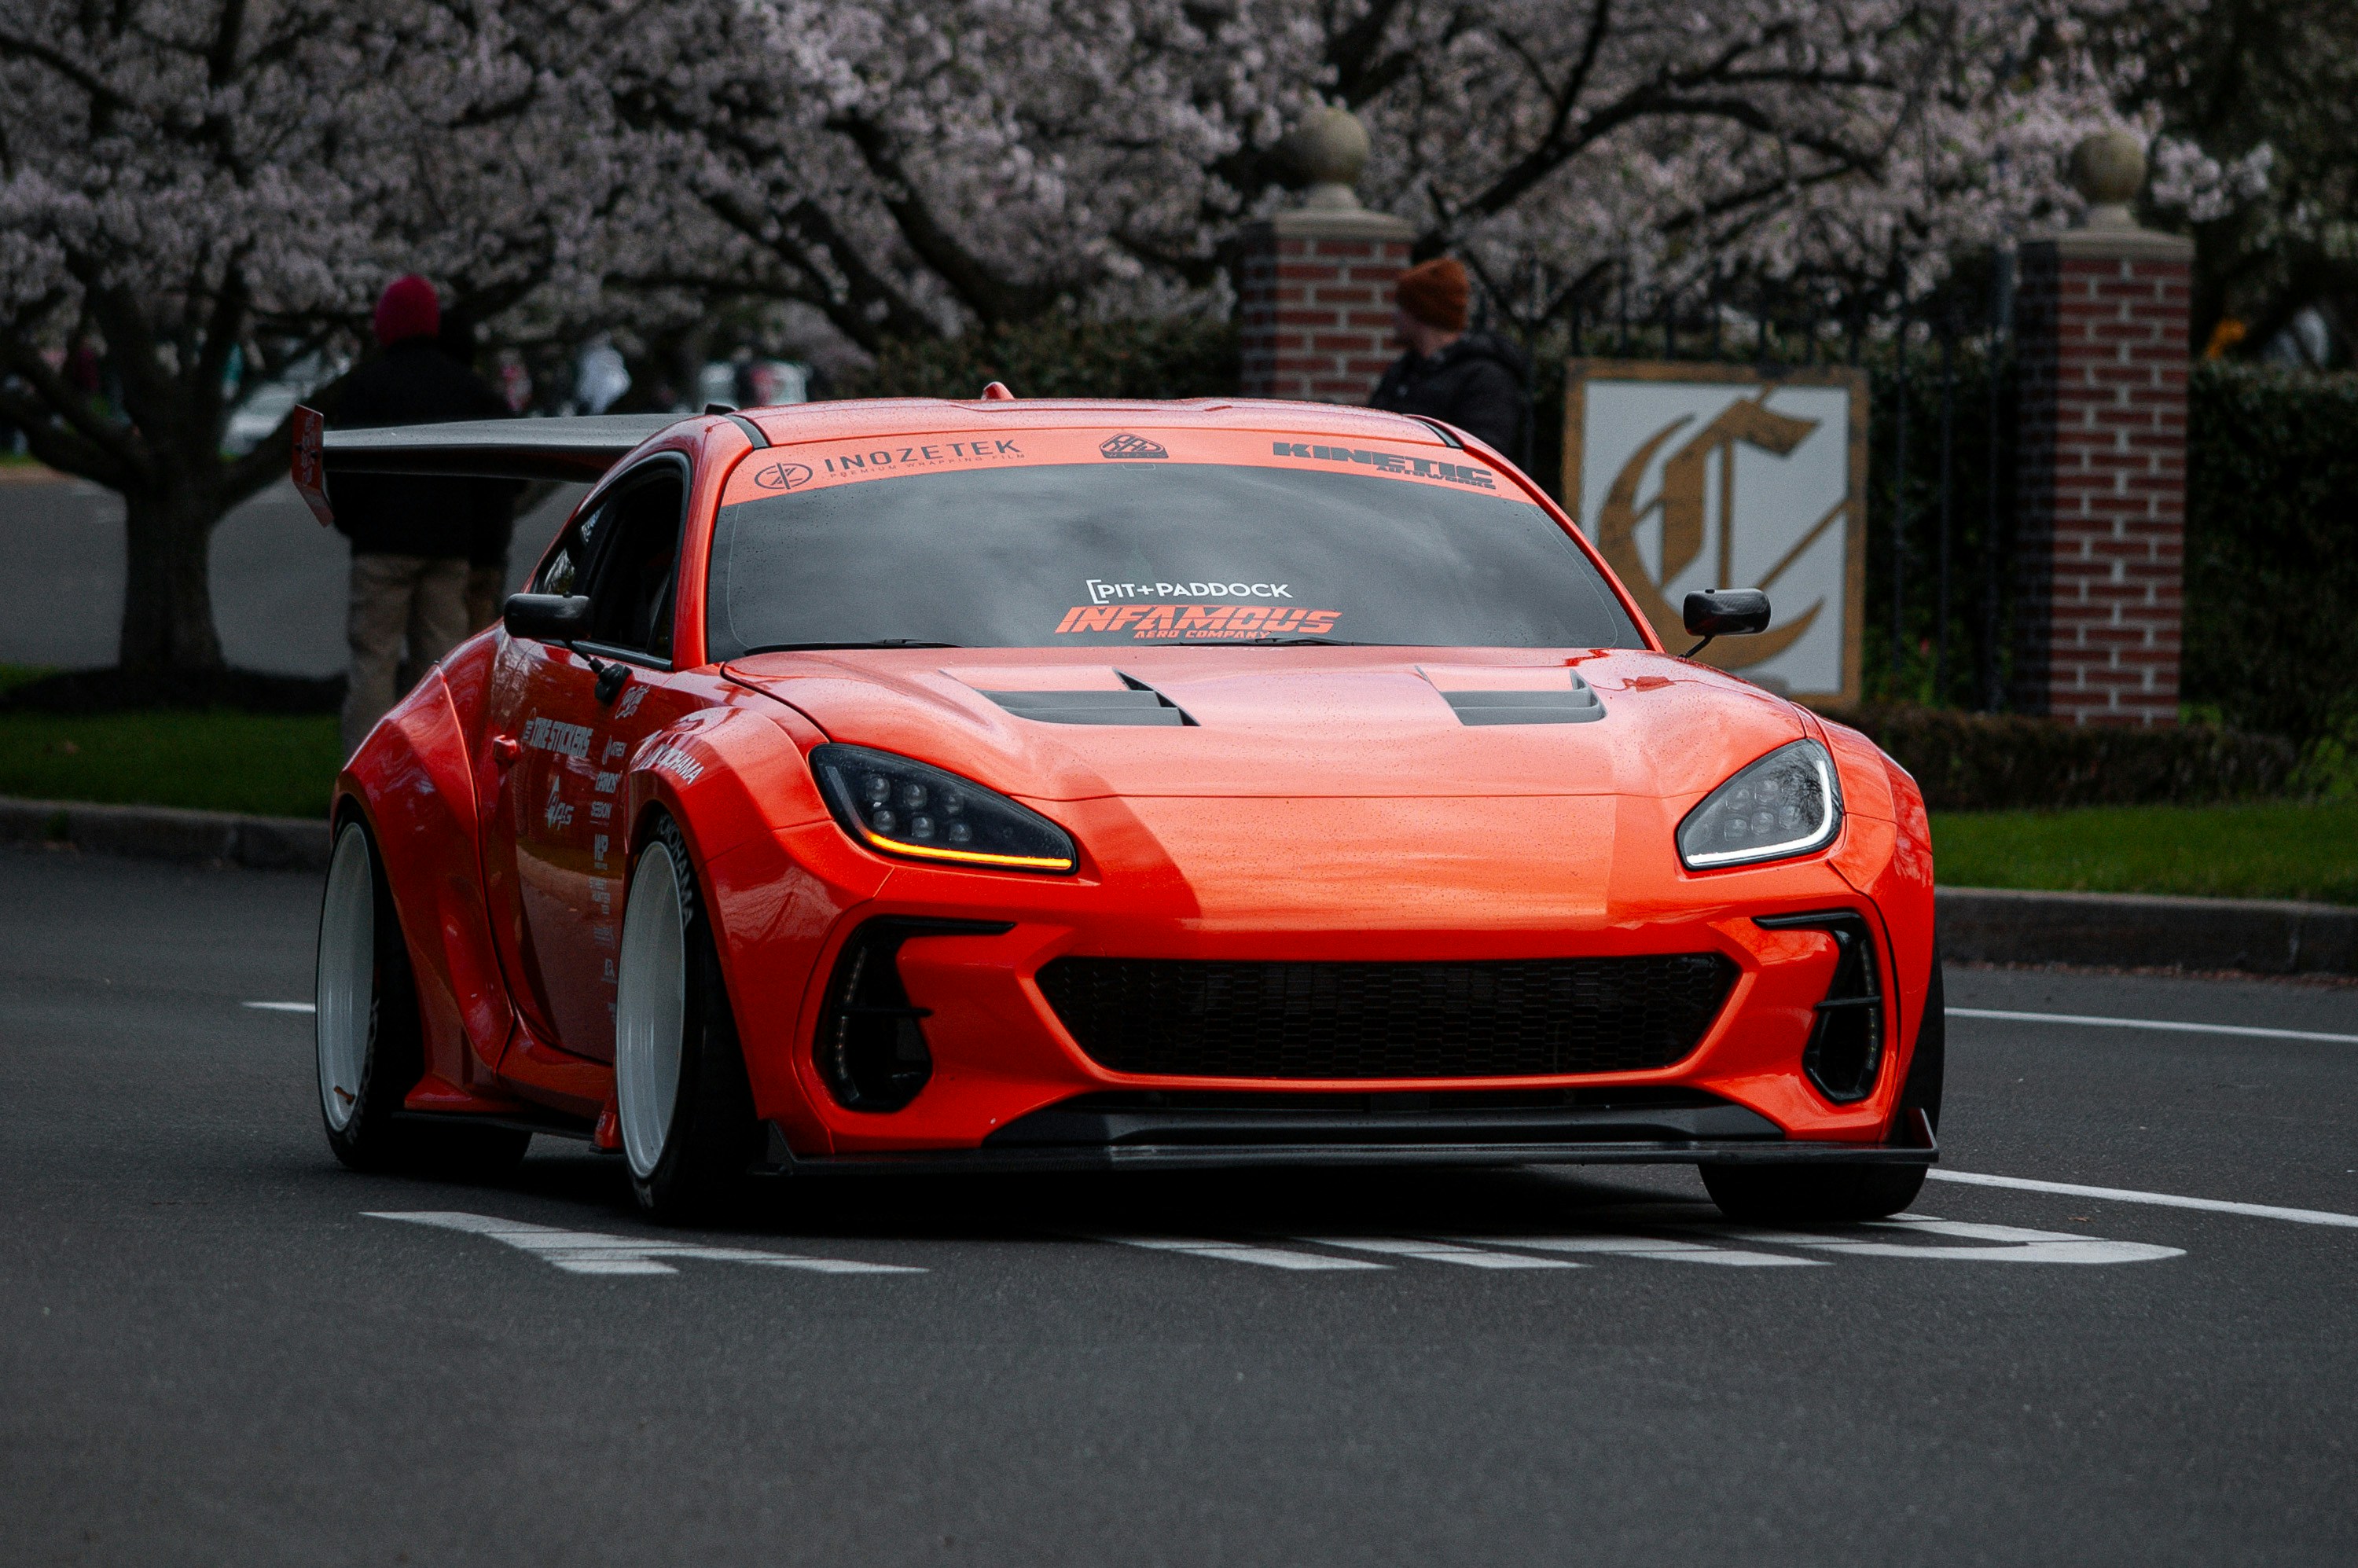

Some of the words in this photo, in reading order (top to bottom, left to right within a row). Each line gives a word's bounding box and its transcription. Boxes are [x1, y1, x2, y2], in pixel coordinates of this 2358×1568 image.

[825, 439, 1022, 473] INOZETEK
[829, 465, 897, 479] PREMIUM
[906, 456, 982, 468] WRAPPING
[1273, 442, 1493, 483] KINETIC
[1376, 465, 1497, 490] AUTOWORKS
[1600, 387, 1847, 670] C
[1055, 604, 1342, 633] INFAMOUS
[1133, 630, 1178, 638] AERO
[1185, 630, 1273, 638] COMPANY
